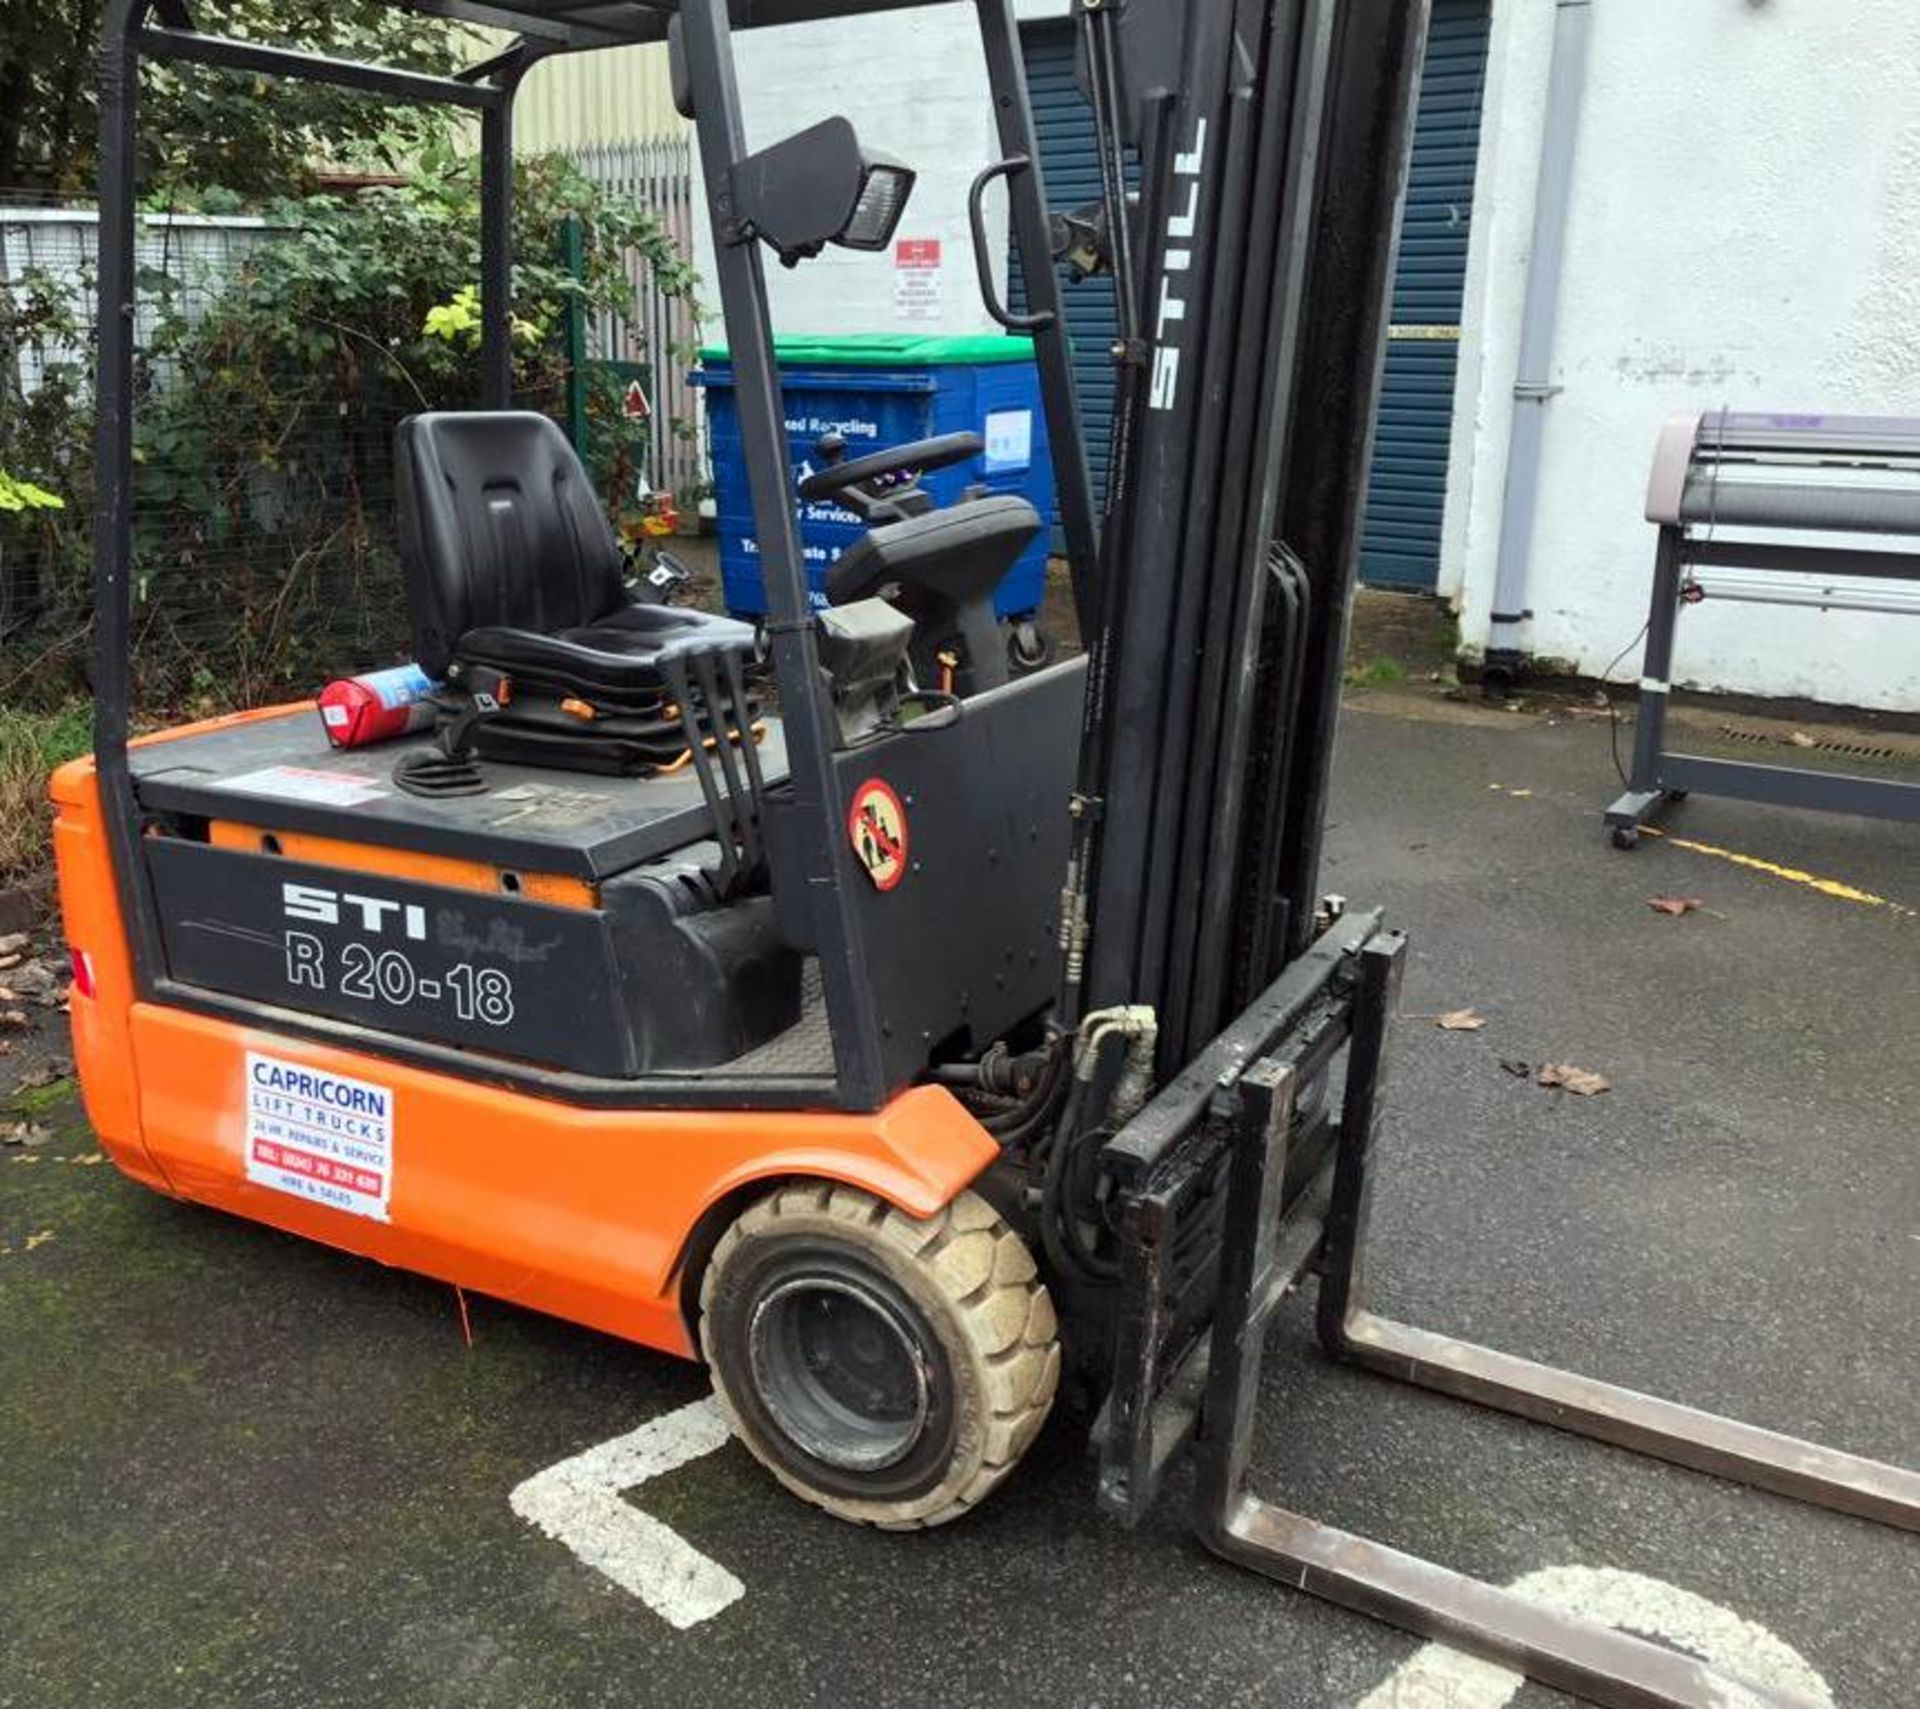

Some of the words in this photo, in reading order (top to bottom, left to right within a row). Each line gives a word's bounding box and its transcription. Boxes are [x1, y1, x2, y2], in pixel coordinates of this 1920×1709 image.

[1150, 118, 1207, 410] STILL
[810, 417, 878, 438] Recycling
[283, 883, 426, 940] STI
[285, 930, 326, 989] R
[340, 942, 514, 1025] 20-18
[254, 1063, 385, 1117] CAPRICORN
[253, 1093, 293, 1116] LIFT
[305, 1107, 385, 1143] TRUCKS
[319, 1184, 352, 1205] SALES
